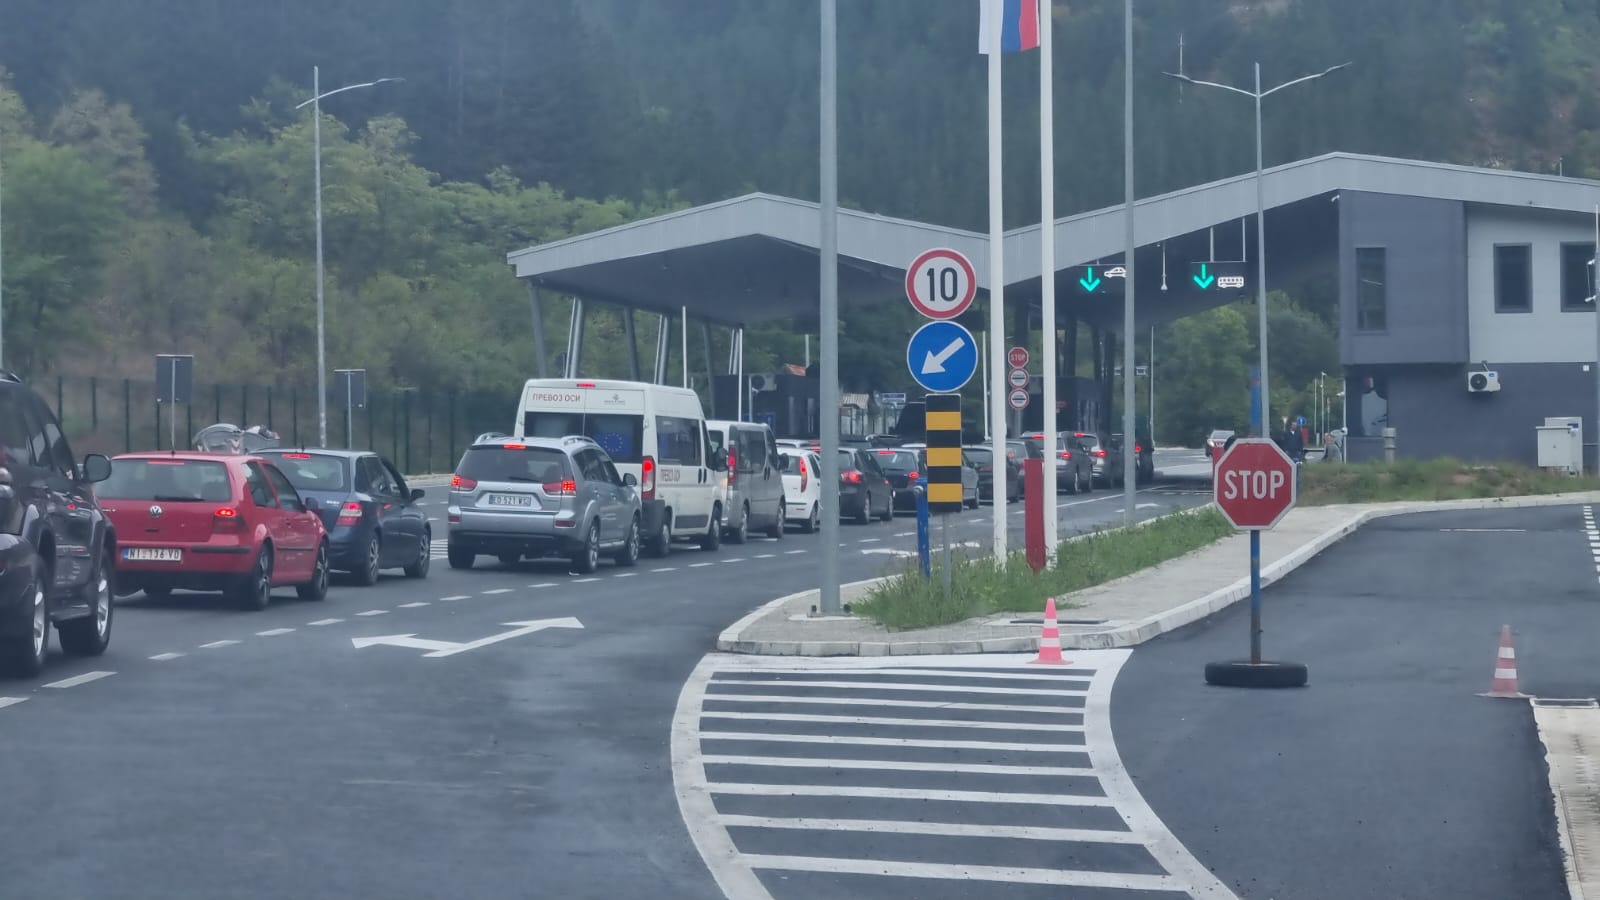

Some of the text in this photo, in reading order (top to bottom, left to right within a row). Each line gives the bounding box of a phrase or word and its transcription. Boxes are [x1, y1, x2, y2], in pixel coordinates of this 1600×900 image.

[927, 267, 958, 302] 10
[1010, 353, 1026, 361] STOP
[532, 392, 563, 402] ПРЕВОЗ
[1224, 470, 1285, 500] STOP
